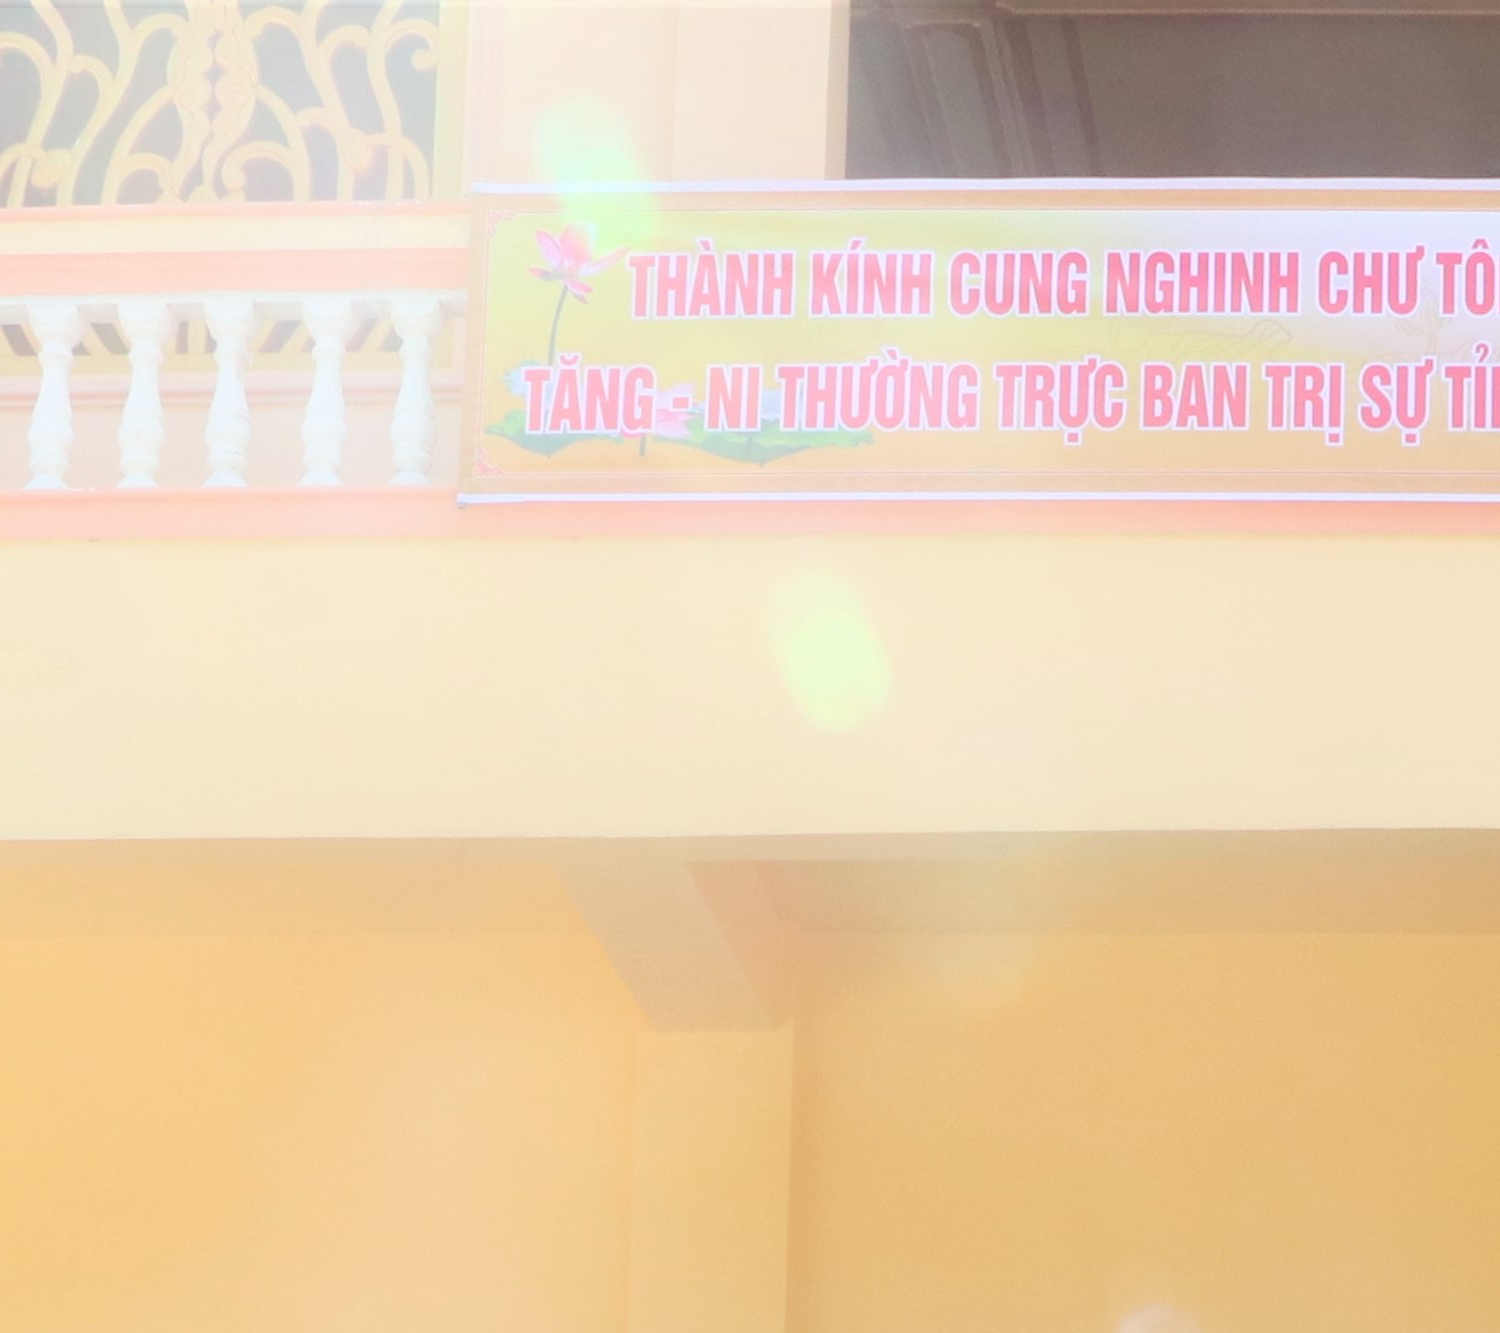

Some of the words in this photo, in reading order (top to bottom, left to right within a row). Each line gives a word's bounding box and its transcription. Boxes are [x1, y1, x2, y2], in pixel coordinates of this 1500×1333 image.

[627, 239, 796, 318] THÀNH
[810, 239, 933, 316] KÍNH
[948, 250, 1090, 316] CUNG
[1104, 249, 1301, 315] NGHINH
[1317, 244, 1427, 316] CHƯ
[523, 353, 656, 432] TĂNG
[706, 364, 762, 430] NI
[777, 348, 979, 431] THƯỜNG
[995, 357, 1126, 445] TRỰC
[1141, 364, 1249, 430] BAN
[1265, 363, 1344, 444] TRỊ
[1358, 358, 1436, 444] SỰ
